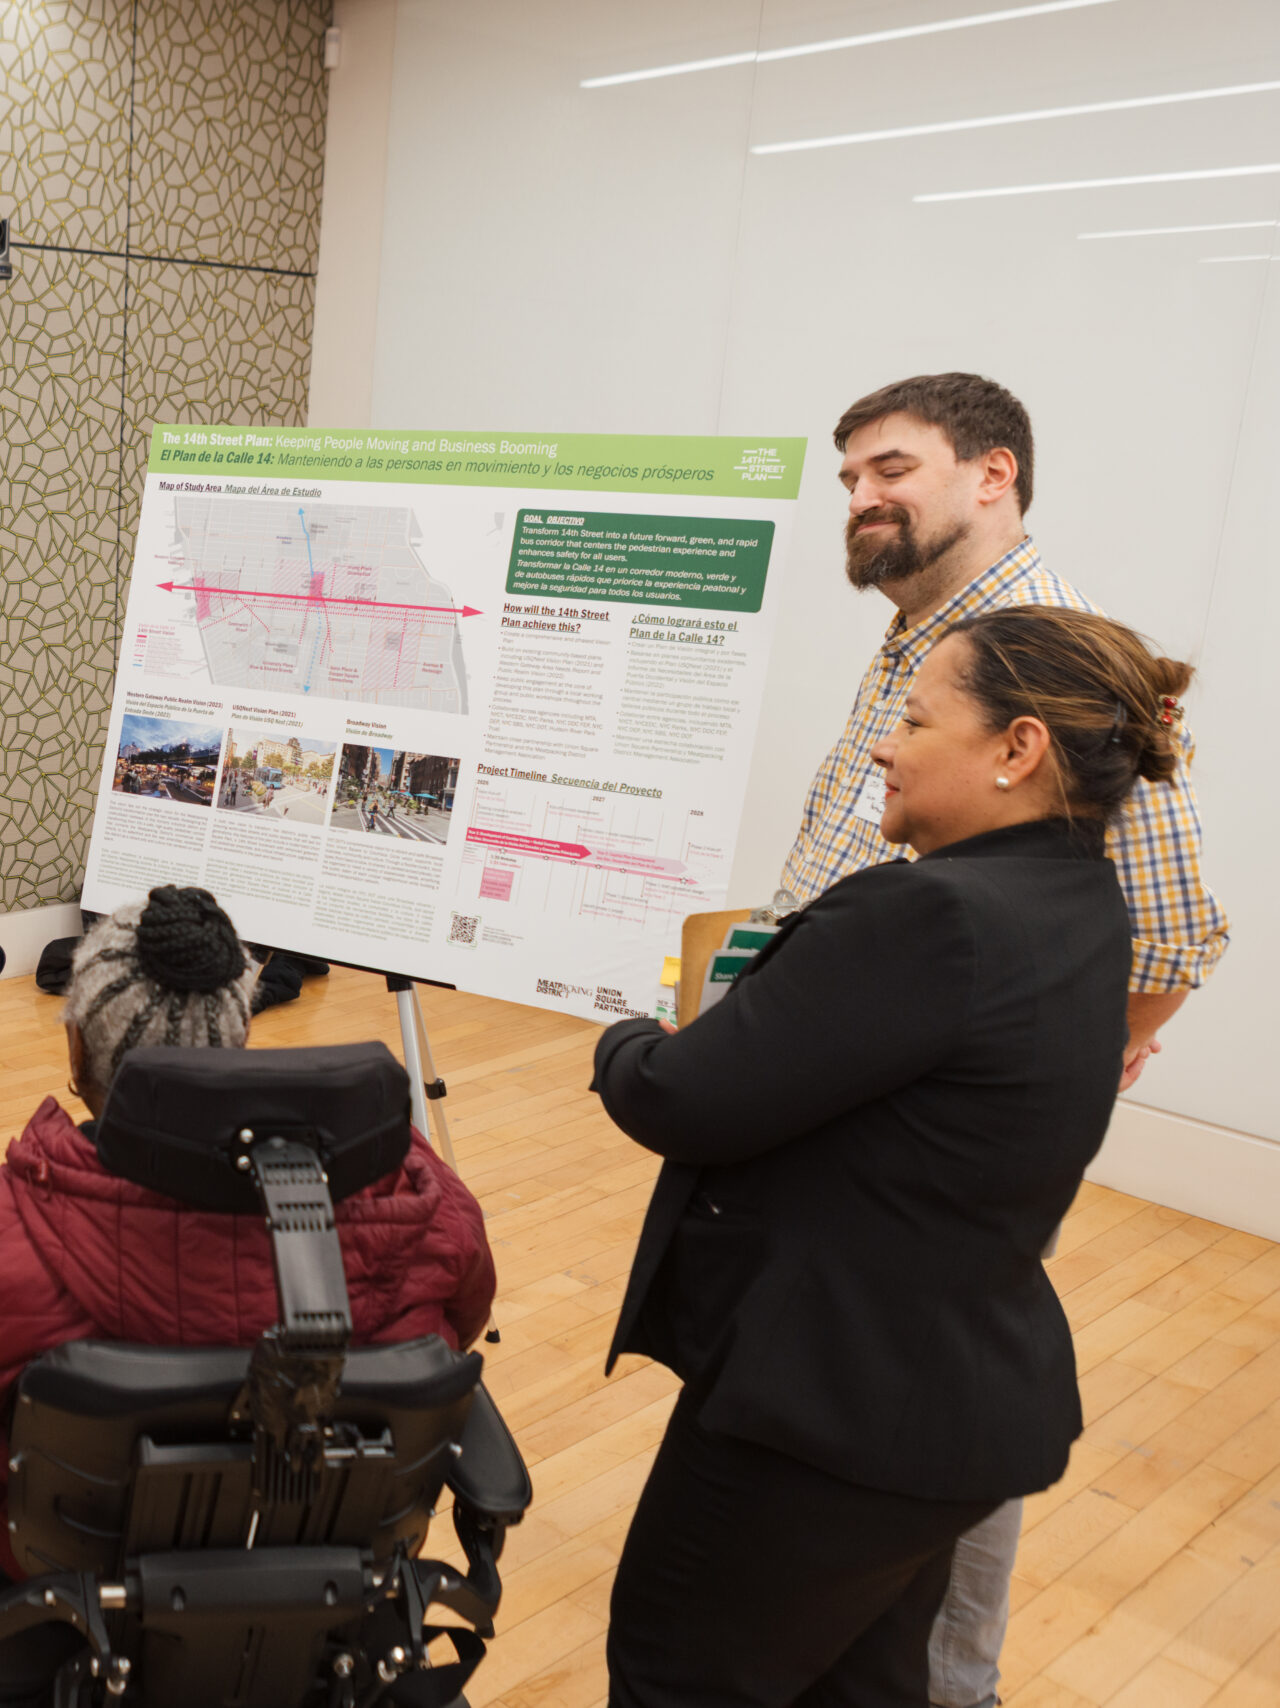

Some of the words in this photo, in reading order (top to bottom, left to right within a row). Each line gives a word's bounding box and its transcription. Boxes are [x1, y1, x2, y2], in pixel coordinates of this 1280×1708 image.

[162, 432, 180, 444] The
[183, 433, 207, 445] 14th
[209, 433, 242, 446] Street
[245, 435, 273, 447] Plan:
[275, 436, 321, 451] Keeping
[324, 436, 363, 450] People
[367, 437, 409, 453] Moving
[412, 439, 435, 452] and
[439, 439, 496, 453] Business
[500, 440, 558, 458] Booming
[757, 448, 777, 457] THE
[160, 450, 172, 461] El
[173, 450, 196, 462] Plan
[198, 451, 211, 462] de
[213, 451, 223, 463] la
[226, 452, 253, 464] Calle
[256, 453, 274, 465] 14:
[277, 453, 352, 468] Manteniendo
[355, 458, 363, 468] a
[366, 456, 383, 469] las
[385, 459, 442, 472] personas
[446, 461, 462, 472] en
[465, 460, 540, 475] movimiento
[542, 464, 551, 477] y
[554, 462, 573, 476] los
[577, 464, 639, 480] negocios
[641, 465, 715, 483] prósperos
[741, 456, 766, 464] 14TH
[742, 472, 767, 481] PLAN
[748, 464, 786, 473] STREET
[159, 481, 175, 492] Map
[176, 483, 183, 491] of
[184, 483, 204, 493] Study
[205, 484, 221, 492] Area
[224, 484, 246, 495] Mapa
[248, 485, 260, 494] del
[261, 483, 279, 496] Área
[281, 486, 291, 496] de
[292, 487, 322, 497] Estudio
[523, 515, 543, 524] GOAL
[522, 526, 559, 535] Transform
[580, 530, 604, 538] Street
[606, 531, 620, 539] into
[629, 532, 653, 540] future
[655, 533, 688, 543] forward,
[689, 536, 716, 545] green,
[718, 537, 734, 546] and
[736, 539, 758, 548] rapid
[518, 548, 555, 557] enhances
[556, 551, 579, 560] safety
[581, 551, 591, 559] for
[536, 538, 564, 547] corridor
[567, 540, 581, 548] that
[583, 541, 612, 550] centers
[614, 542, 626, 551] the
[628, 543, 671, 553] pedestrian
[673, 547, 717, 556] experience
[719, 549, 736, 557] and
[517, 560, 562, 569] Transformar
[563, 562, 570, 570] la
[572, 563, 592, 571] Calle
[593, 564, 604, 572] 14
[630, 567, 664, 577] corredor
[665, 570, 704, 580] moderno,
[706, 573, 730, 581] verde
[730, 575, 737, 583] y
[513, 582, 539, 591] mejore
[549, 584, 587, 594] seguridad
[588, 587, 607, 595] para
[608, 588, 630, 597] todos
[632, 589, 643, 598] los
[514, 570, 524, 578] de
[526, 571, 565, 580] autobuses
[567, 573, 595, 583] rápidos
[596, 576, 612, 584] que
[613, 577, 643, 586] priorice
[645, 579, 652, 587] la
[654, 580, 701, 590] experiencia
[702, 584, 740, 593] peatonal
[740, 587, 747, 595] y
[503, 603, 523, 613] How
[524, 604, 539, 614] will
[541, 605, 556, 616] the
[558, 607, 579, 618] 14th
[581, 609, 610, 620] Street
[501, 617, 521, 627] Plan
[522, 619, 556, 630] achieve
[558, 622, 581, 632] this?
[631, 613, 665, 625] ¿Cómo
[667, 615, 702, 628] logrará
[704, 620, 725, 630] esto
[727, 621, 738, 630] el
[629, 627, 651, 638] Plan
[653, 629, 665, 640] de
[667, 631, 676, 641] la
[678, 632, 703, 643] Calle
[706, 634, 725, 645] 14?
[477, 763, 509, 776] Project
[510, 768, 548, 782] Timeline
[551, 773, 600, 789] Secuencia
[602, 780, 618, 792] del
[620, 783, 663, 798] Proyecto
[596, 986, 622, 997] UNION
[595, 995, 627, 1007] SQUARE
[593, 1003, 649, 1019] PARTNERSHIP
